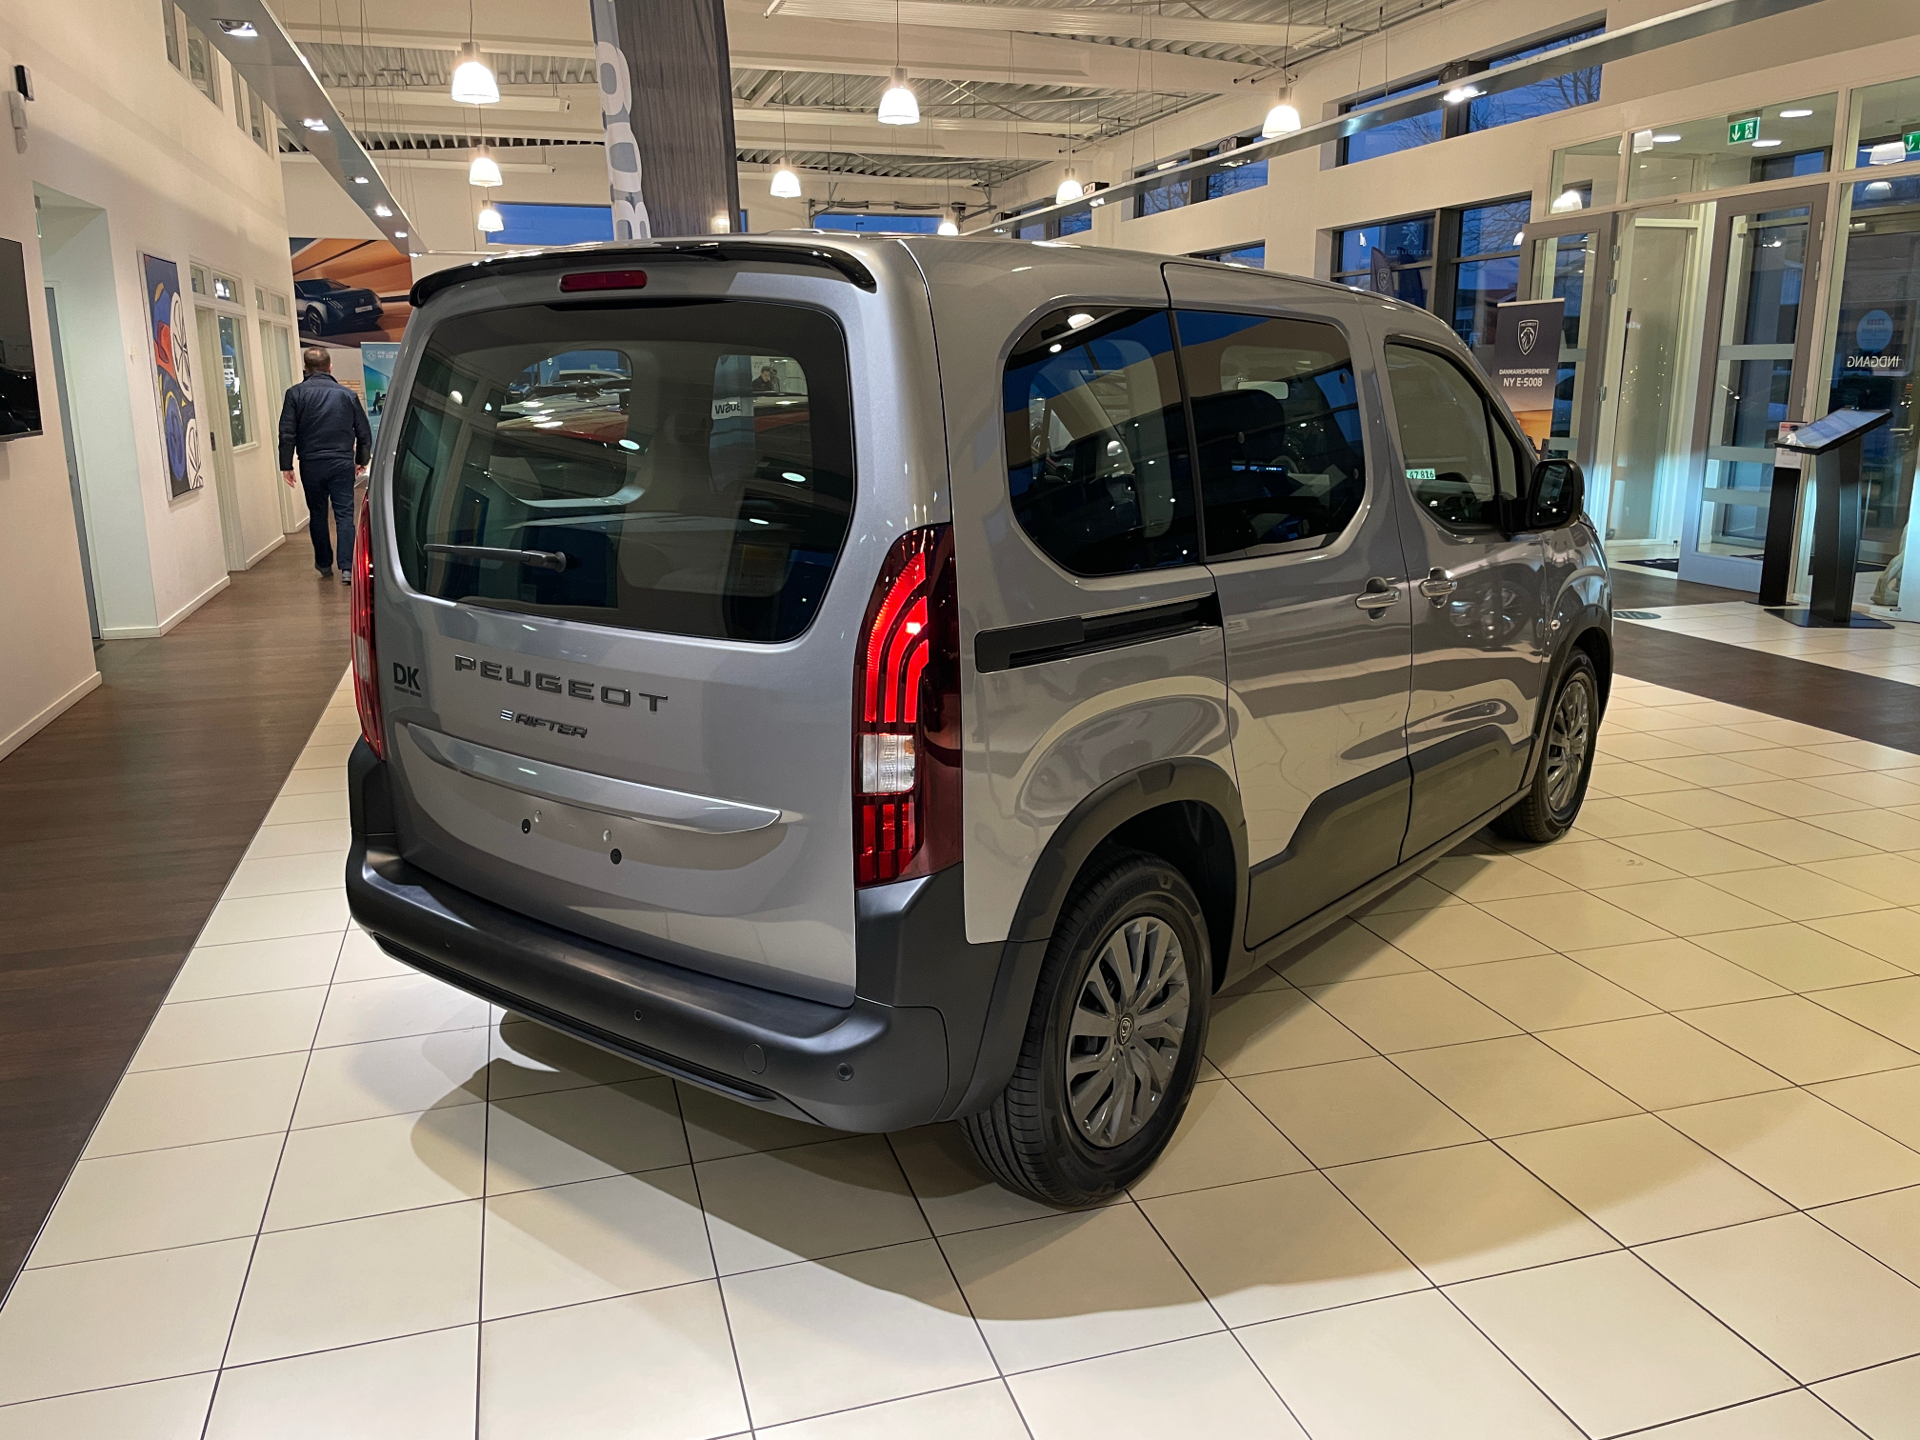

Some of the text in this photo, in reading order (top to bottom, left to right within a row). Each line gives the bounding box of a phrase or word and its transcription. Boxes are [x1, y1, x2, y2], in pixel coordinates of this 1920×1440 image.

[1503, 377, 1543, 387] NY E-5008
[393, 662, 421, 691] DK
[455, 654, 669, 712] PEUGEOT
